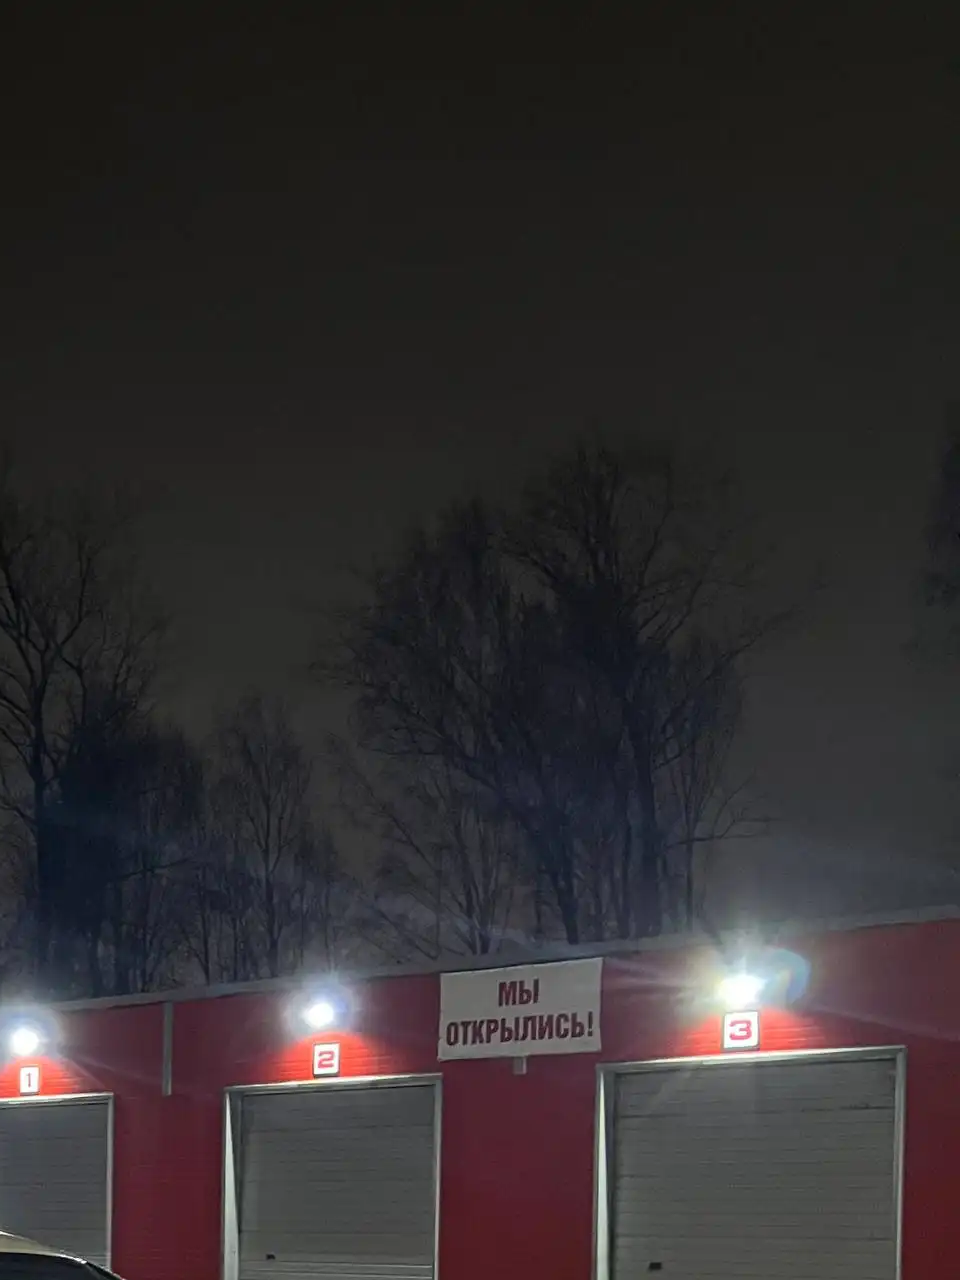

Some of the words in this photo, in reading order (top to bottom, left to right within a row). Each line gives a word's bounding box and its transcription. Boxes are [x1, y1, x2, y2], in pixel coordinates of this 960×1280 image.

[497, 978, 540, 1007] МЫ
[445, 1011, 594, 1047] ОТКРЫЛИСЬ!
[728, 1019, 753, 1041] 3
[317, 1050, 335, 1069] 2
